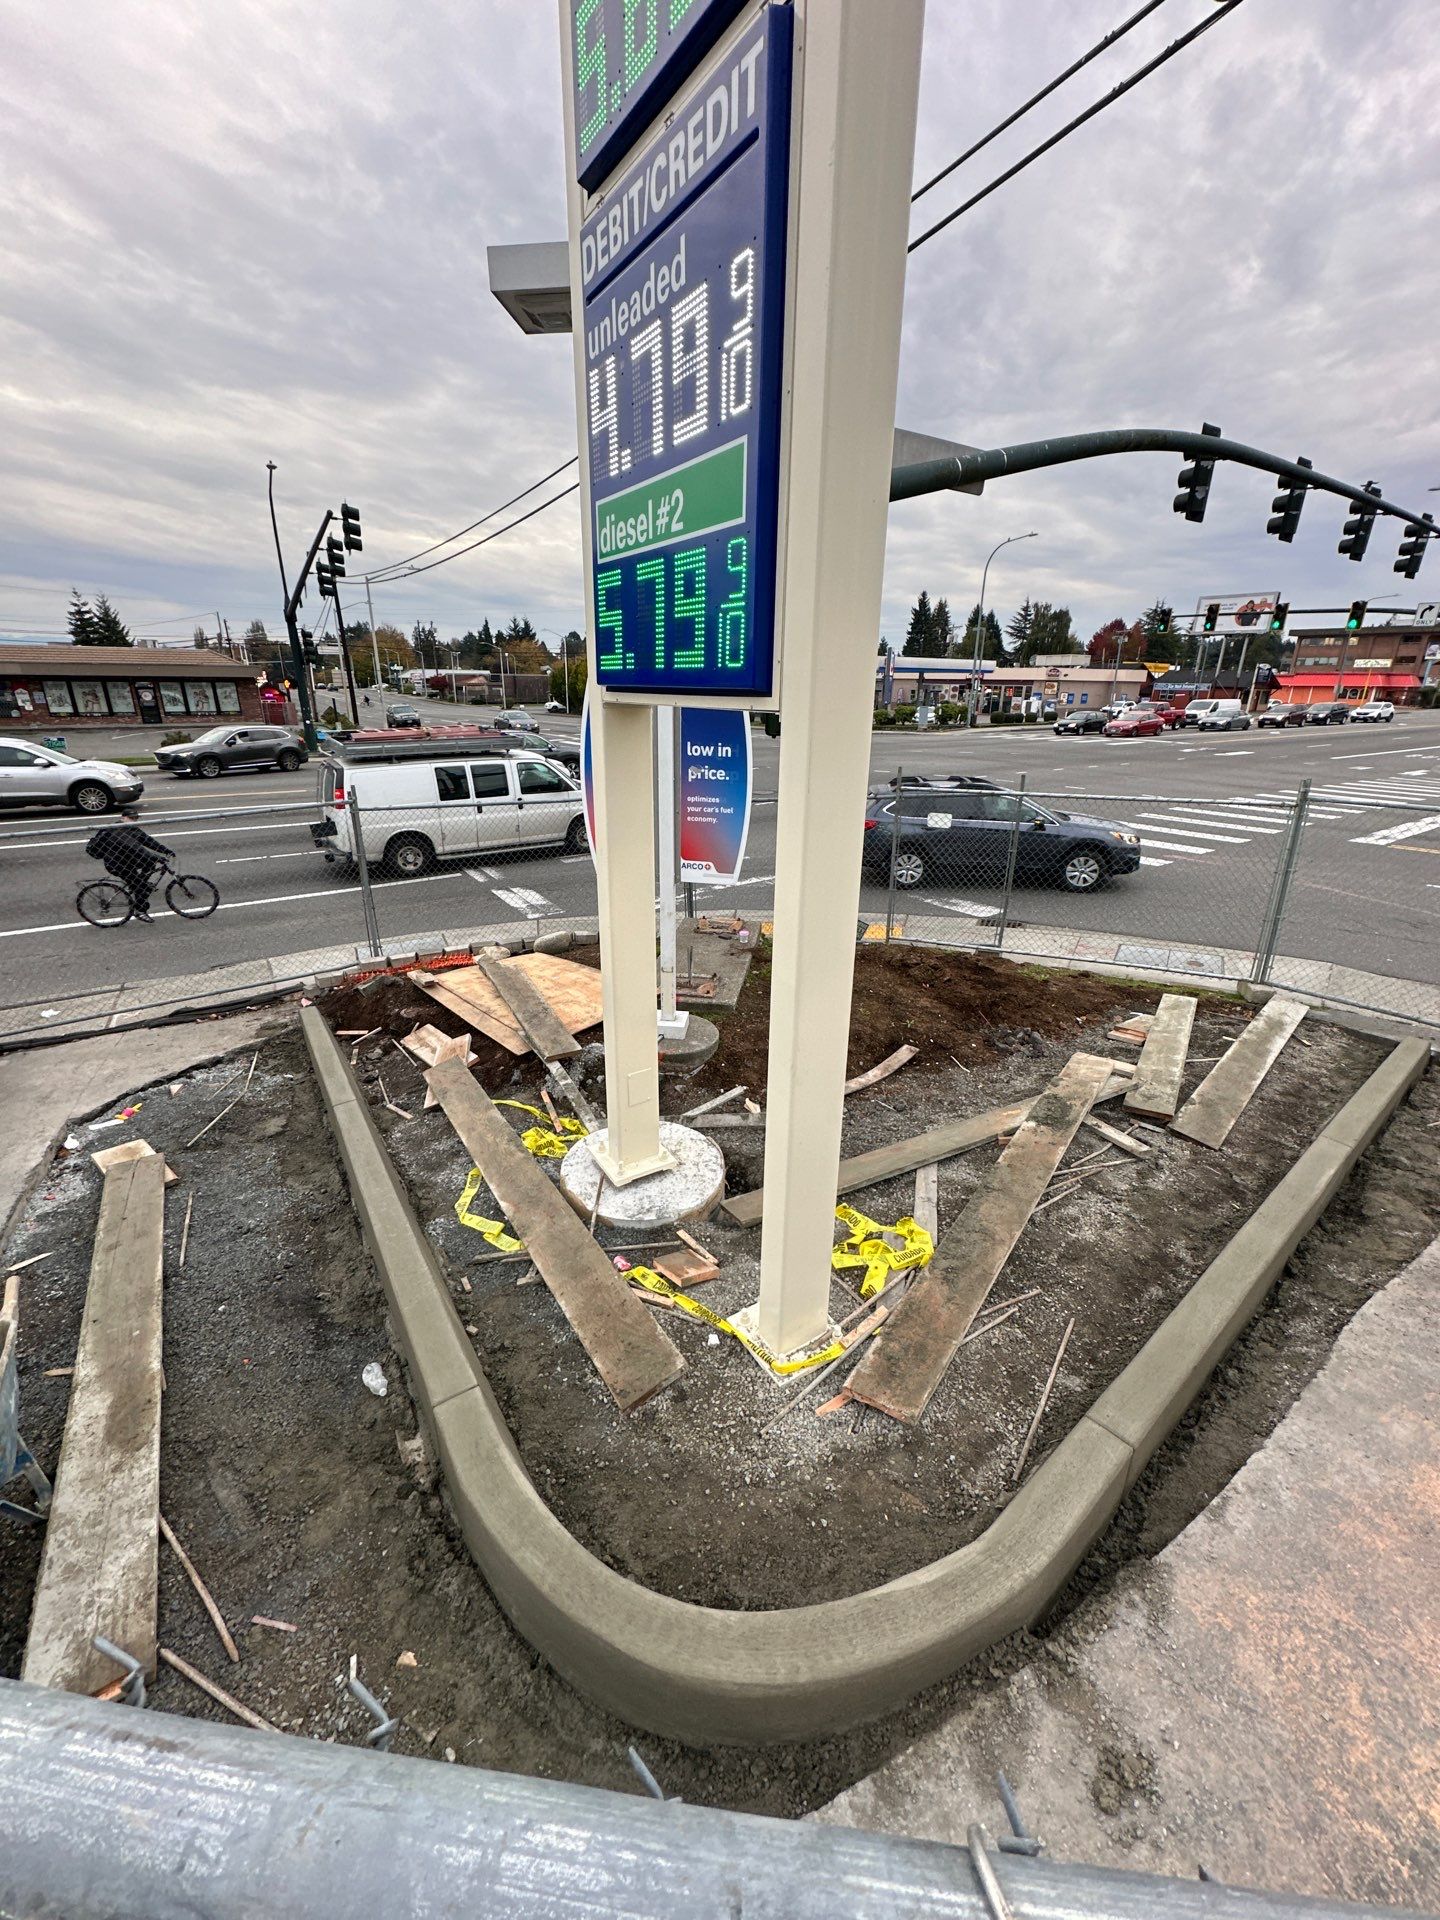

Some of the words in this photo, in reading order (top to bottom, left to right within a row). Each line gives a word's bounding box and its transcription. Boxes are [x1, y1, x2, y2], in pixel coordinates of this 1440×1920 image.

[582, 35, 765, 286] DEBIT/CREDIT
[588, 235, 686, 361] unleaded
[589, 282, 709, 477] 4.79
[600, 498, 653, 554] diesel
[656, 488, 684, 535] #2
[598, 547, 706, 670] 5.79
[687, 741, 714, 757] low
[717, 742, 732, 758] in
[688, 765, 730, 783] price.
[686, 795, 720, 804] optimizes
[686, 805, 702, 813] your
[703, 806, 719, 814] car's
[720, 806, 734, 815] fuel
[686, 815, 719, 825] economy.
[681, 862, 704, 871] ARCO
[893, 1246, 926, 1263] CUIDADO
